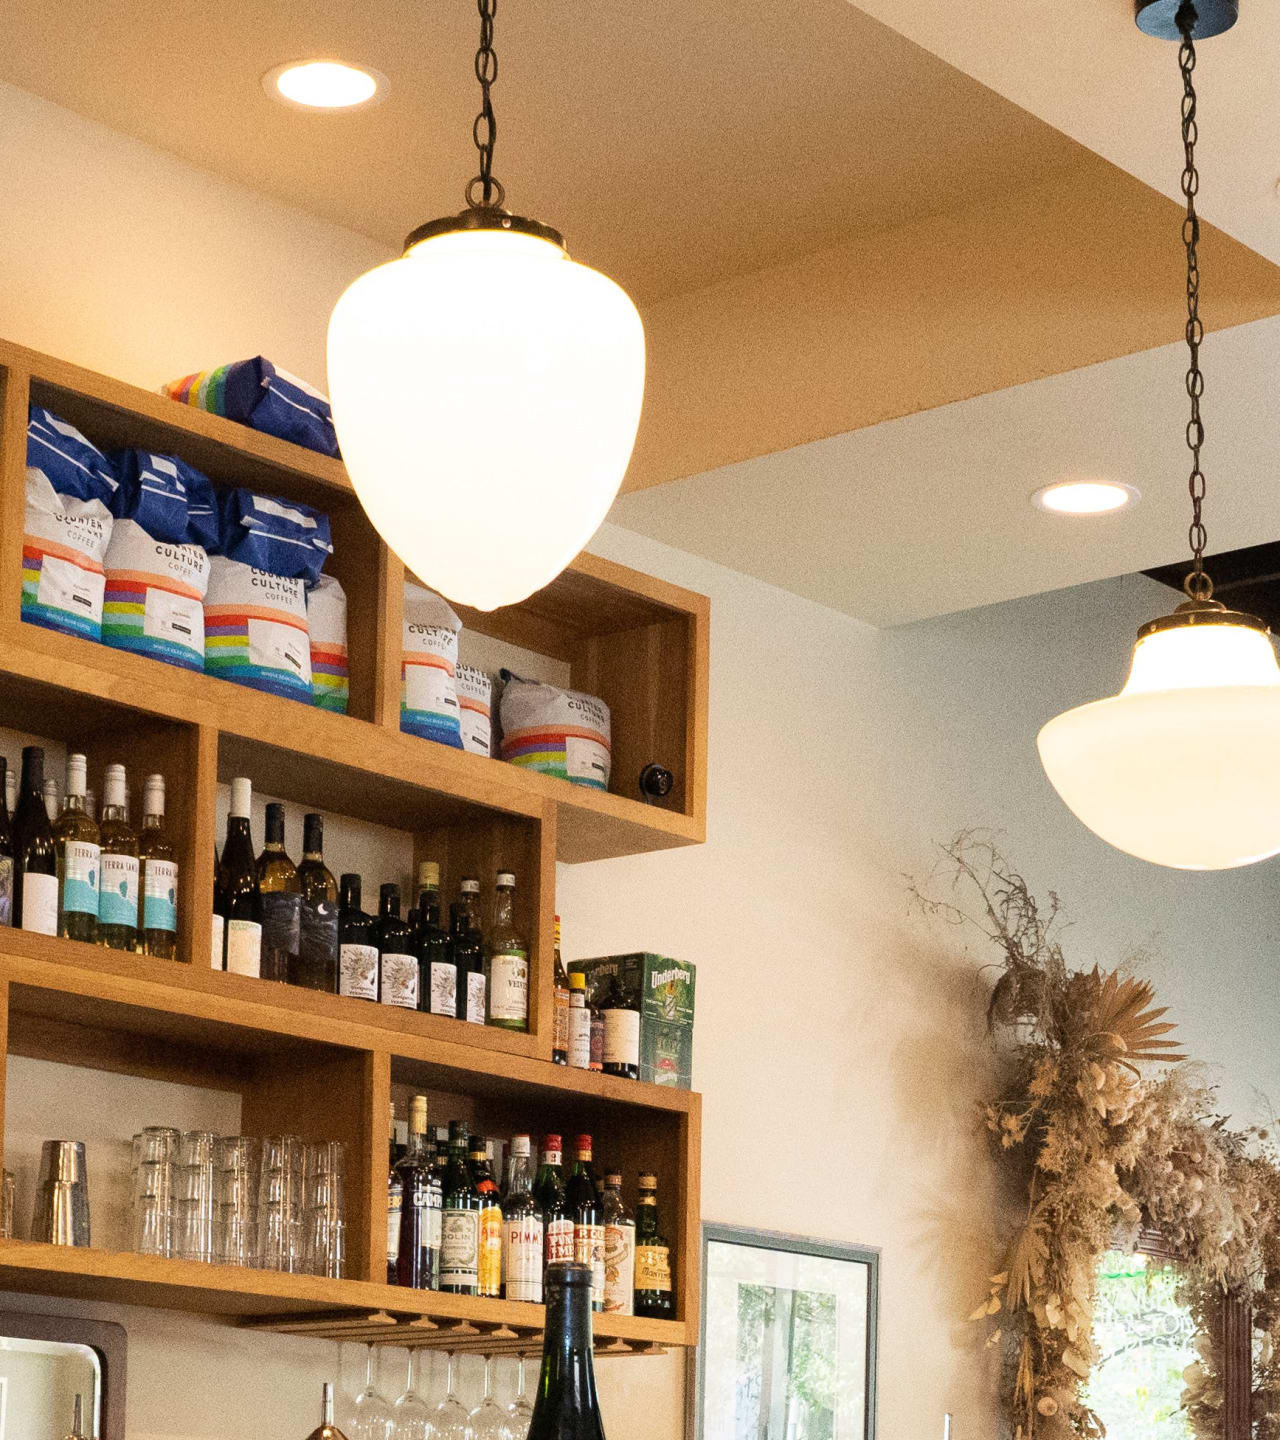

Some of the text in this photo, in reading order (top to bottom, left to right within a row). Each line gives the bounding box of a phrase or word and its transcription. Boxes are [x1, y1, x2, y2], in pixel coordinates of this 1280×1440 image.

[155, 545, 203, 574] CULTURE
[251, 577, 298, 599] CULTURE
[74, 847, 93, 859] TERRA
[104, 860, 124, 870] TERRA
[155, 866, 172, 877] TERRA
[651, 967, 691, 989] Underberg
